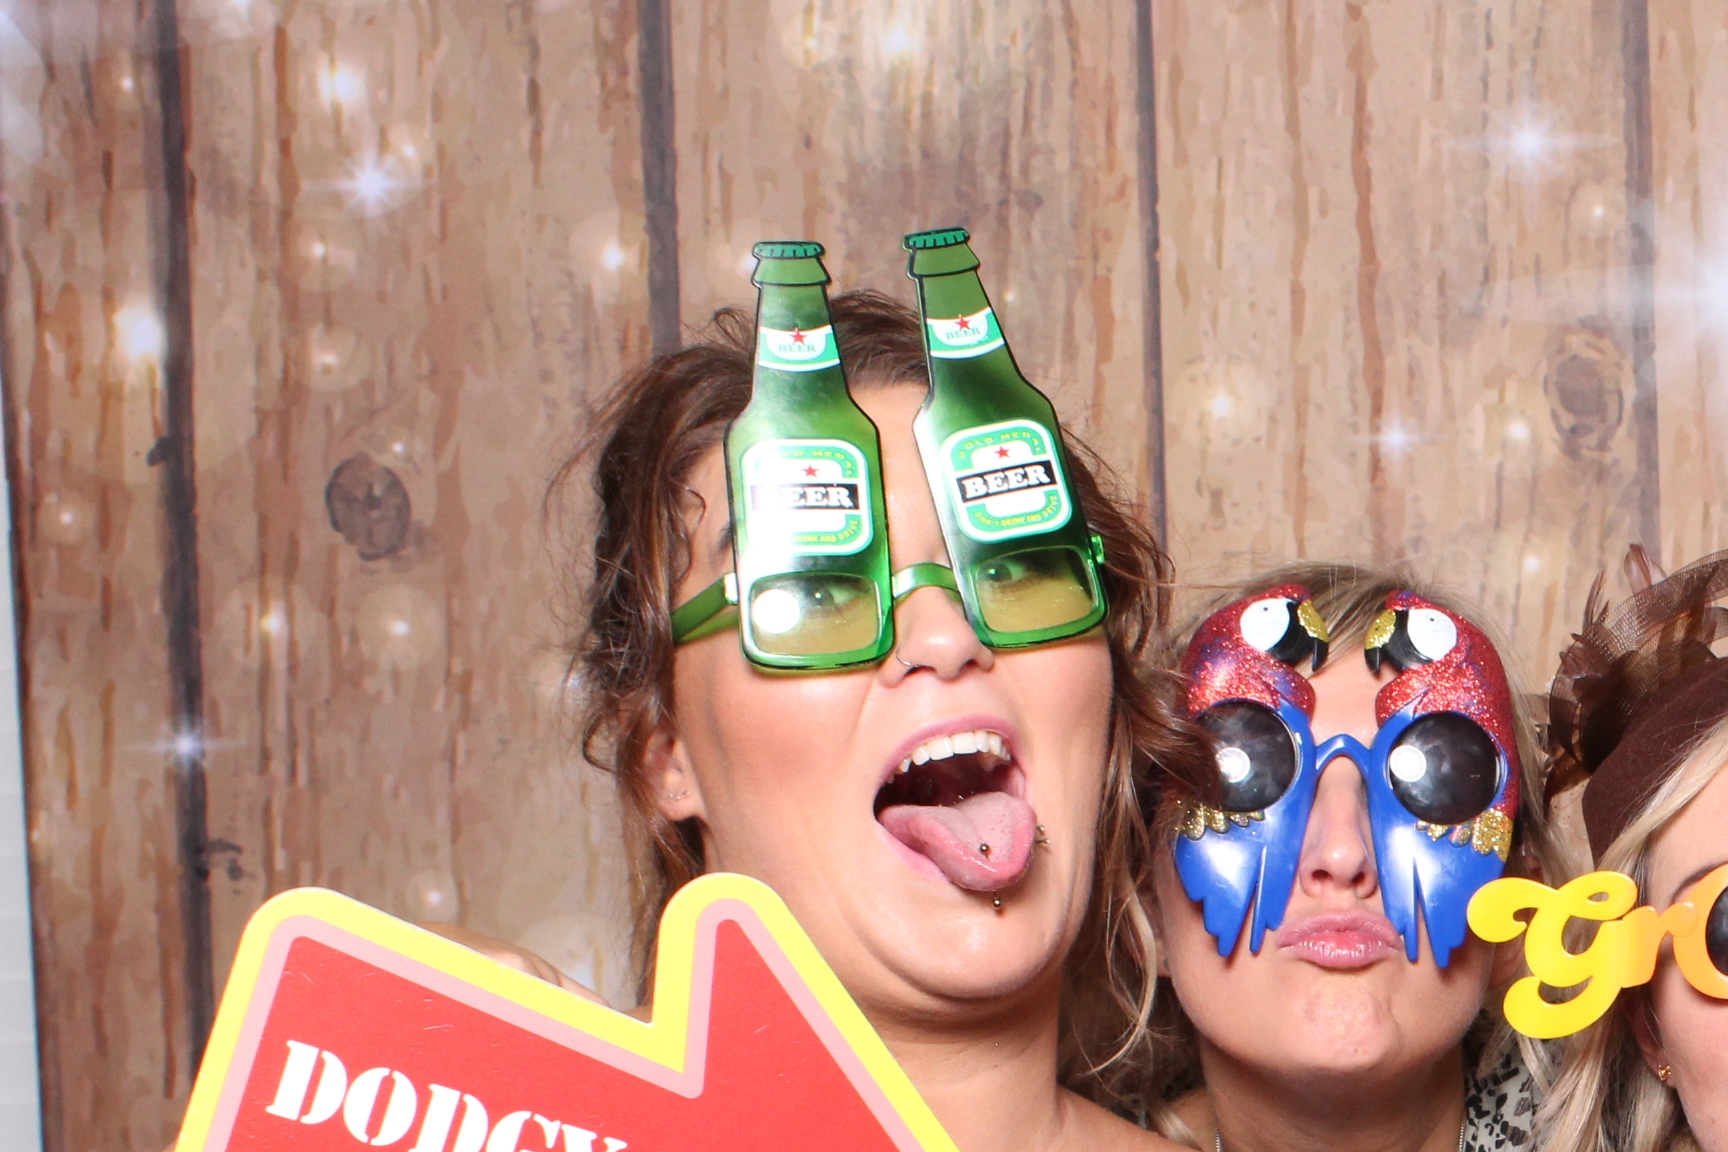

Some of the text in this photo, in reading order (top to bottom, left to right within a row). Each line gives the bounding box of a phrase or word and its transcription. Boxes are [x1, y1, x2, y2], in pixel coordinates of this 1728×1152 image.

[945, 327, 982, 341] BEER
[778, 343, 817, 354] BEER
[958, 430, 1042, 459] GOLD MEDAL
[812, 450, 854, 477] MEDAL
[961, 464, 1052, 499] BEER
[756, 485, 855, 509] EER
[1000, 516, 1026, 528] DRINK
[1026, 512, 1043, 523] AND
[1042, 495, 1058, 518] DRIVE
[820, 534, 838, 543] AND
